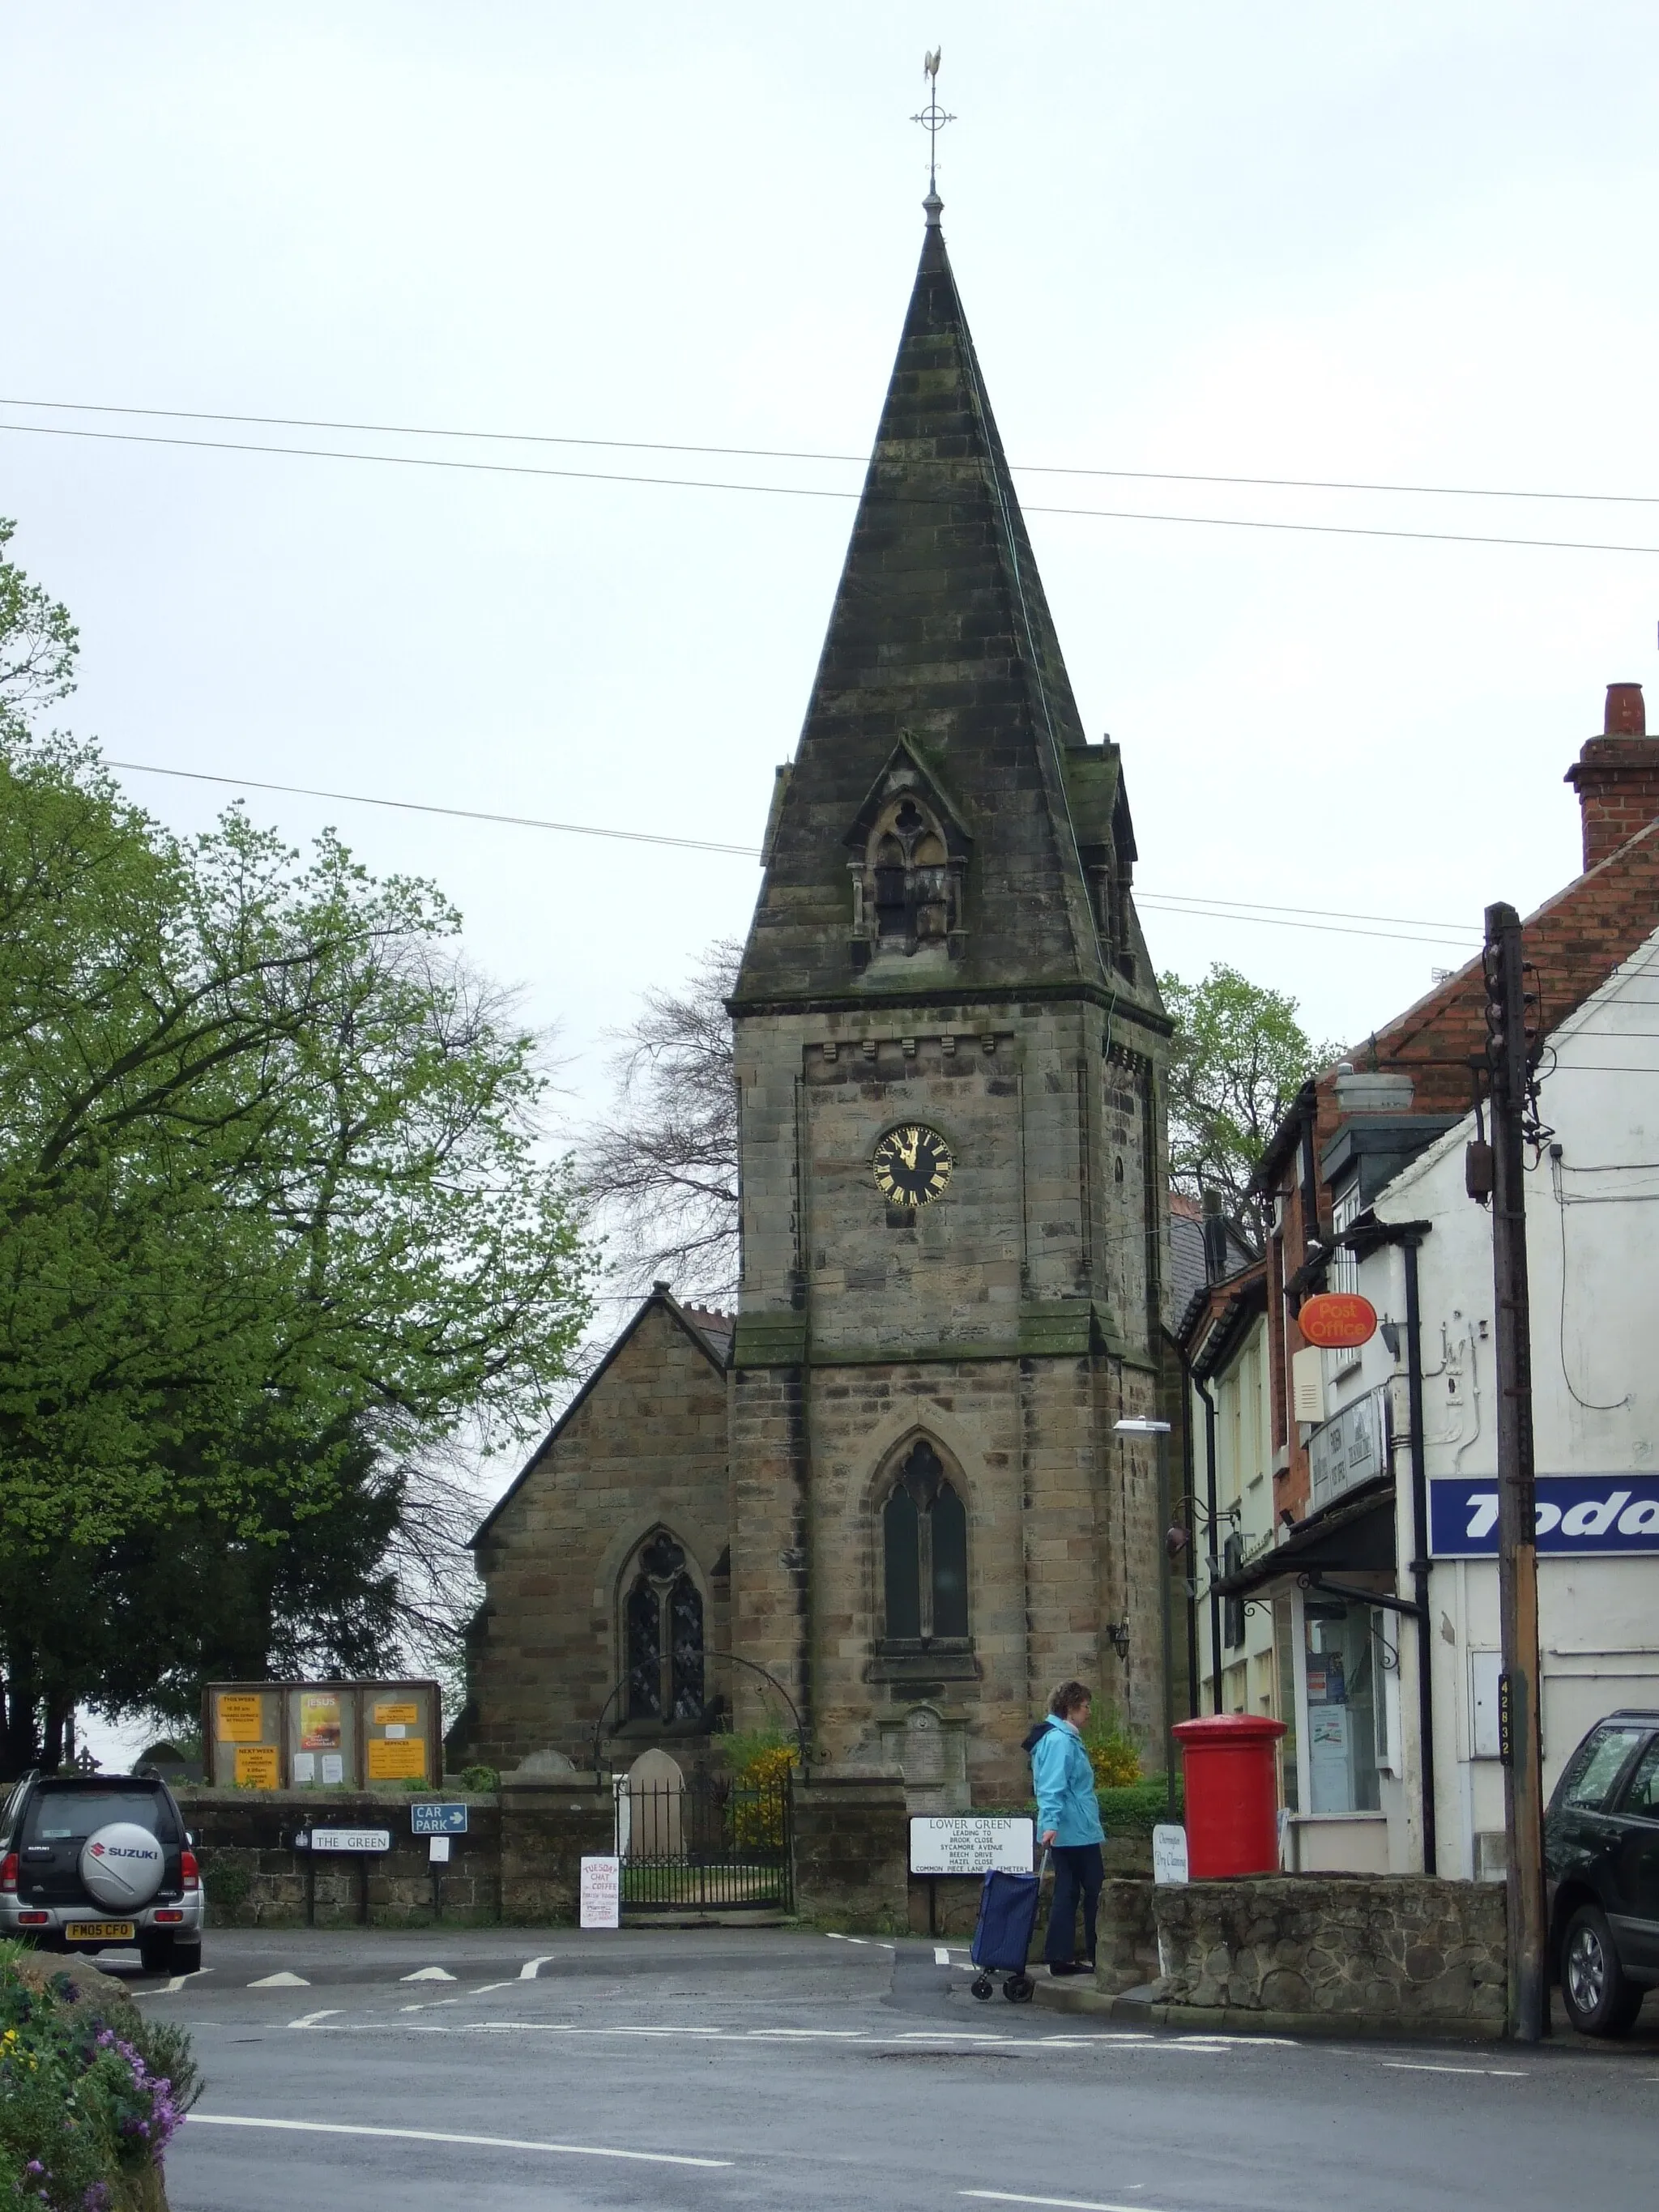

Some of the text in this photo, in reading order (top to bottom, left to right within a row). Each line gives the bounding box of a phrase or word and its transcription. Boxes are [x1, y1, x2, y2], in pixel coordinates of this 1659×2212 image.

[1320, 1302, 1358, 1319] Post
[1311, 1320, 1367, 1337] Office
[308, 1698, 335, 1707] JESUS
[416, 1807, 441, 1818] CAR
[416, 1820, 448, 1831] PARK
[929, 1819, 1012, 1829] LOWER GREEN
[317, 1837, 386, 1848] THE GREEN
[109, 1847, 158, 1860] SUZUKI
[583, 1864, 617, 1873] TUESDAY
